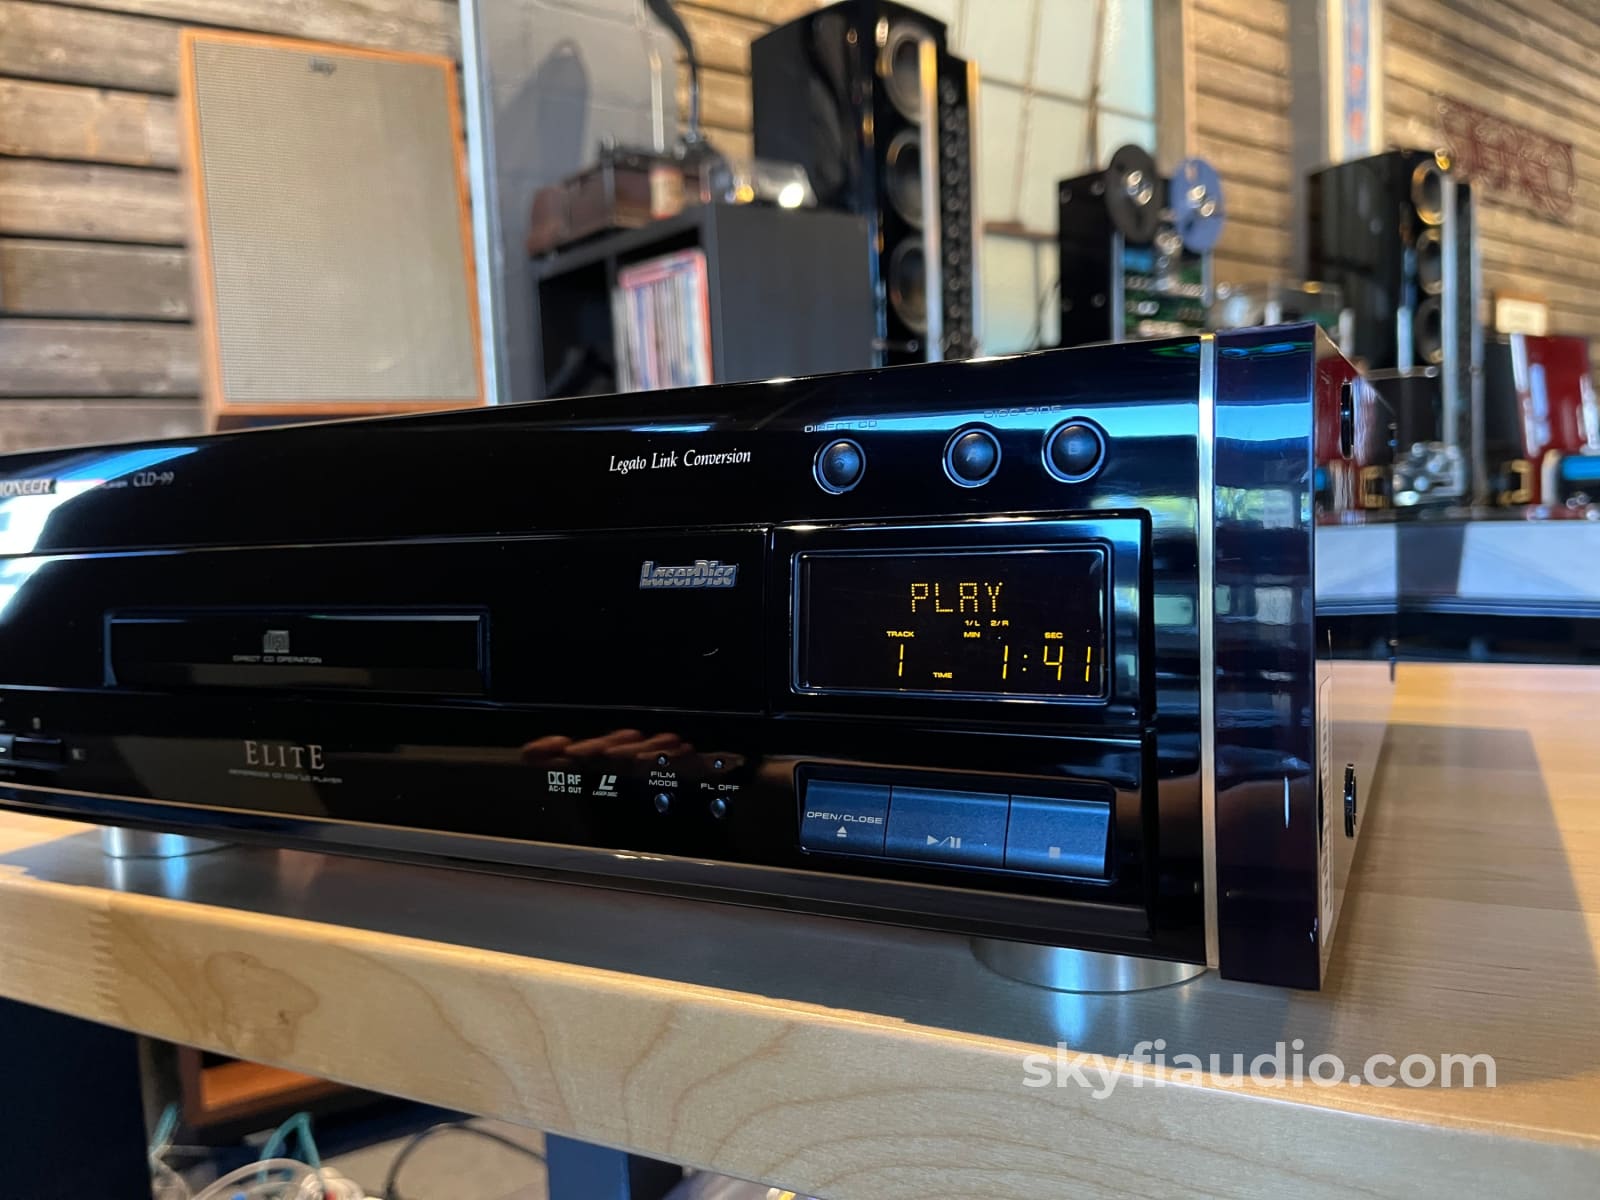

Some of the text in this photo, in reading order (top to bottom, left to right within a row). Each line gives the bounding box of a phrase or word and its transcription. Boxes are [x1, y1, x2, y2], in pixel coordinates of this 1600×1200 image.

[984, 405, 1062, 419] DISC SIDE
[858, 420, 878, 429] CD
[609, 448, 751, 475] Legato Link Conversion
[133, 471, 174, 487] CLD-99
[0, 480, 52, 497] IONEER
[640, 559, 738, 589] LaserDisc
[911, 582, 1003, 613] PLAY
[990, 619, 1009, 627] 2/R
[886, 630, 1063, 640] TRACK MIN SEC
[276, 655, 322, 664] OPERATION
[897, 643, 904, 677] 1
[932, 671, 953, 679] TIME
[244, 740, 325, 770] ELITE
[567, 774, 582, 785] RF
[650, 771, 676, 779] FILM
[648, 779, 678, 788] MODE
[568, 786, 582, 794] OUT
[806, 811, 883, 825] OPEN/CLOSE
